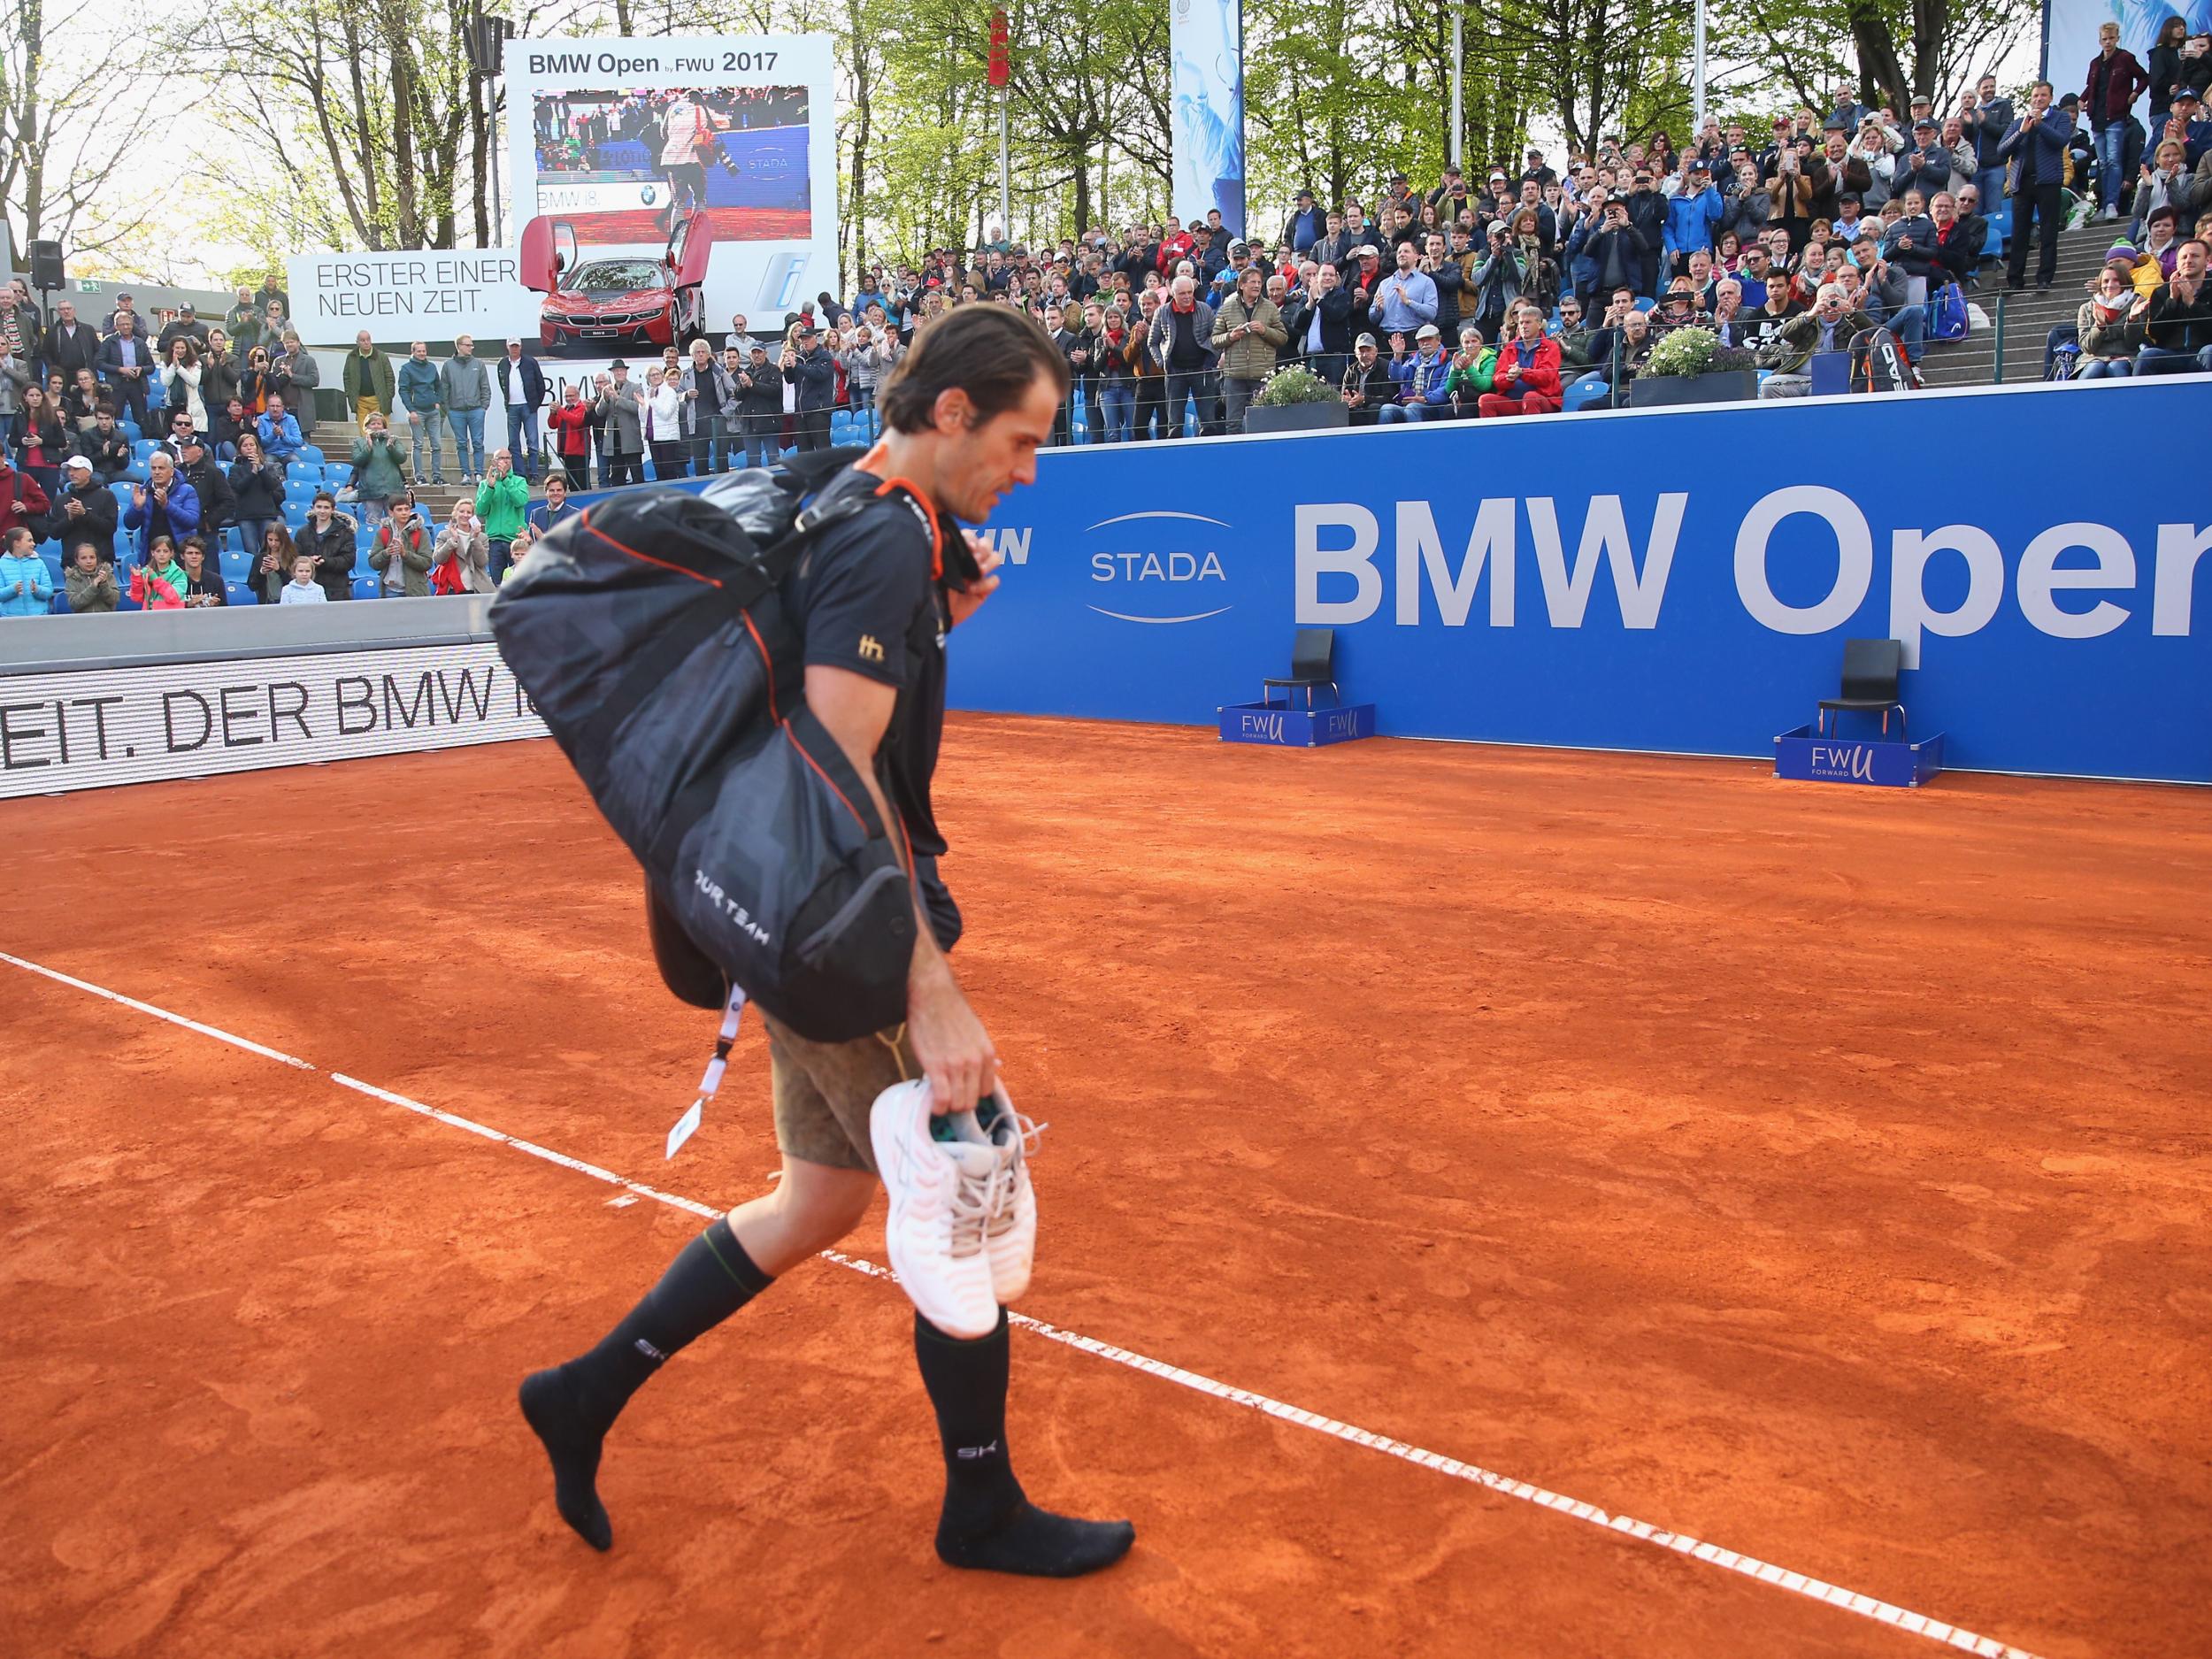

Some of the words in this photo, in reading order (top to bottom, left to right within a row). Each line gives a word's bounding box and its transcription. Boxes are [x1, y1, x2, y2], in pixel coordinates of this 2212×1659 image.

[529, 54, 592, 74] BMW
[597, 53, 660, 77] Open
[675, 58, 714, 72] FWU
[722, 52, 779, 72] 2017
[748, 157, 788, 169] STADA
[537, 190, 580, 209] BMW
[318, 262, 426, 288] ERSTER
[436, 259, 517, 284] EINER
[319, 291, 413, 317] NEUEN
[423, 289, 488, 313] ZEIT.
[1090, 551, 1227, 582] STADA
[1294, 492, 1689, 630] BMW
[0, 695, 134, 770] EIT.
[163, 681, 313, 753] DER
[335, 665, 495, 736] BMW
[1811, 768, 1849, 778] FORWARD
[726, 898, 770, 947] TEAM
